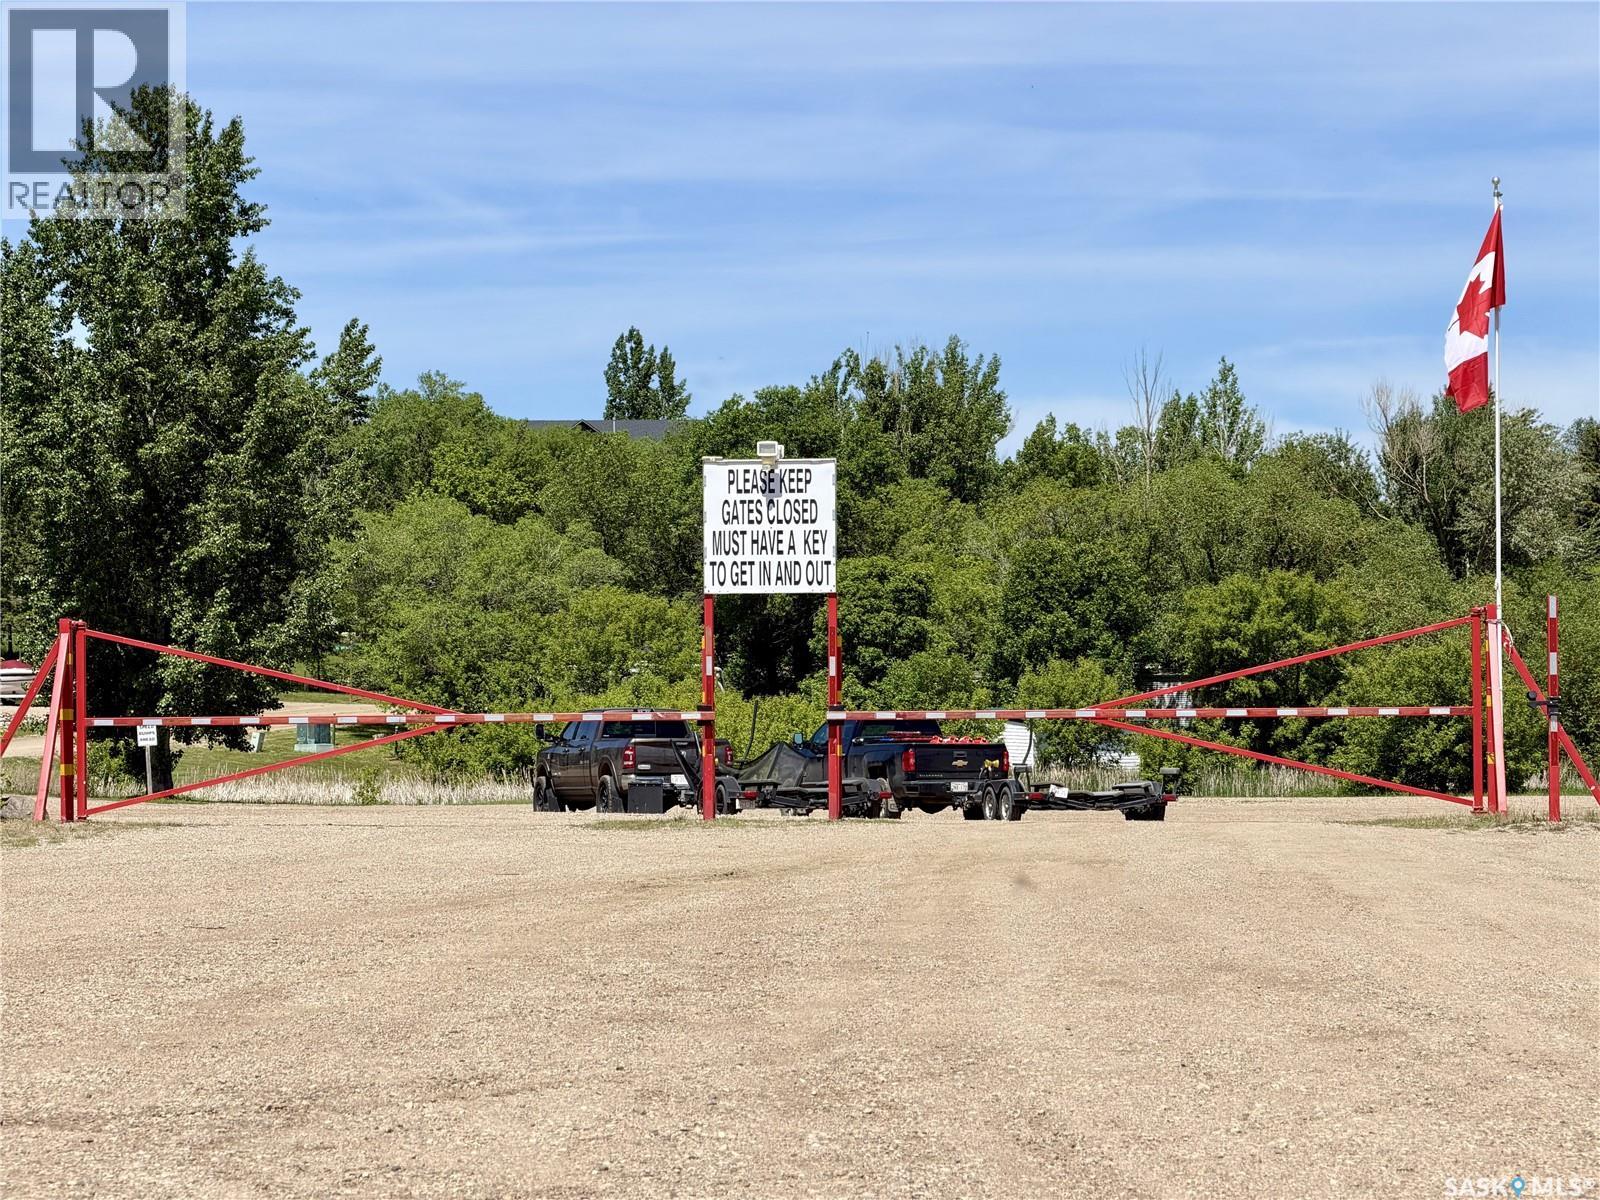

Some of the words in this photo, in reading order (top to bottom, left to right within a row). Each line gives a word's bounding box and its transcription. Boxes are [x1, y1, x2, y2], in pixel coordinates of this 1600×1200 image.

[727, 468, 776, 494] PLEASE
[779, 468, 812, 494] KEEP
[721, 499, 763, 525] GATES
[767, 498, 818, 525] CLOSED
[712, 530, 747, 556] MUST
[751, 529, 784, 556] HAVE
[787, 529, 797, 556] A
[803, 529, 828, 556] KEY
[709, 560, 727, 587] TO
[730, 560, 755, 586] GET
[758, 560, 771, 586] IN
[775, 560, 802, 586] AND
[805, 560, 832, 586] OUT
